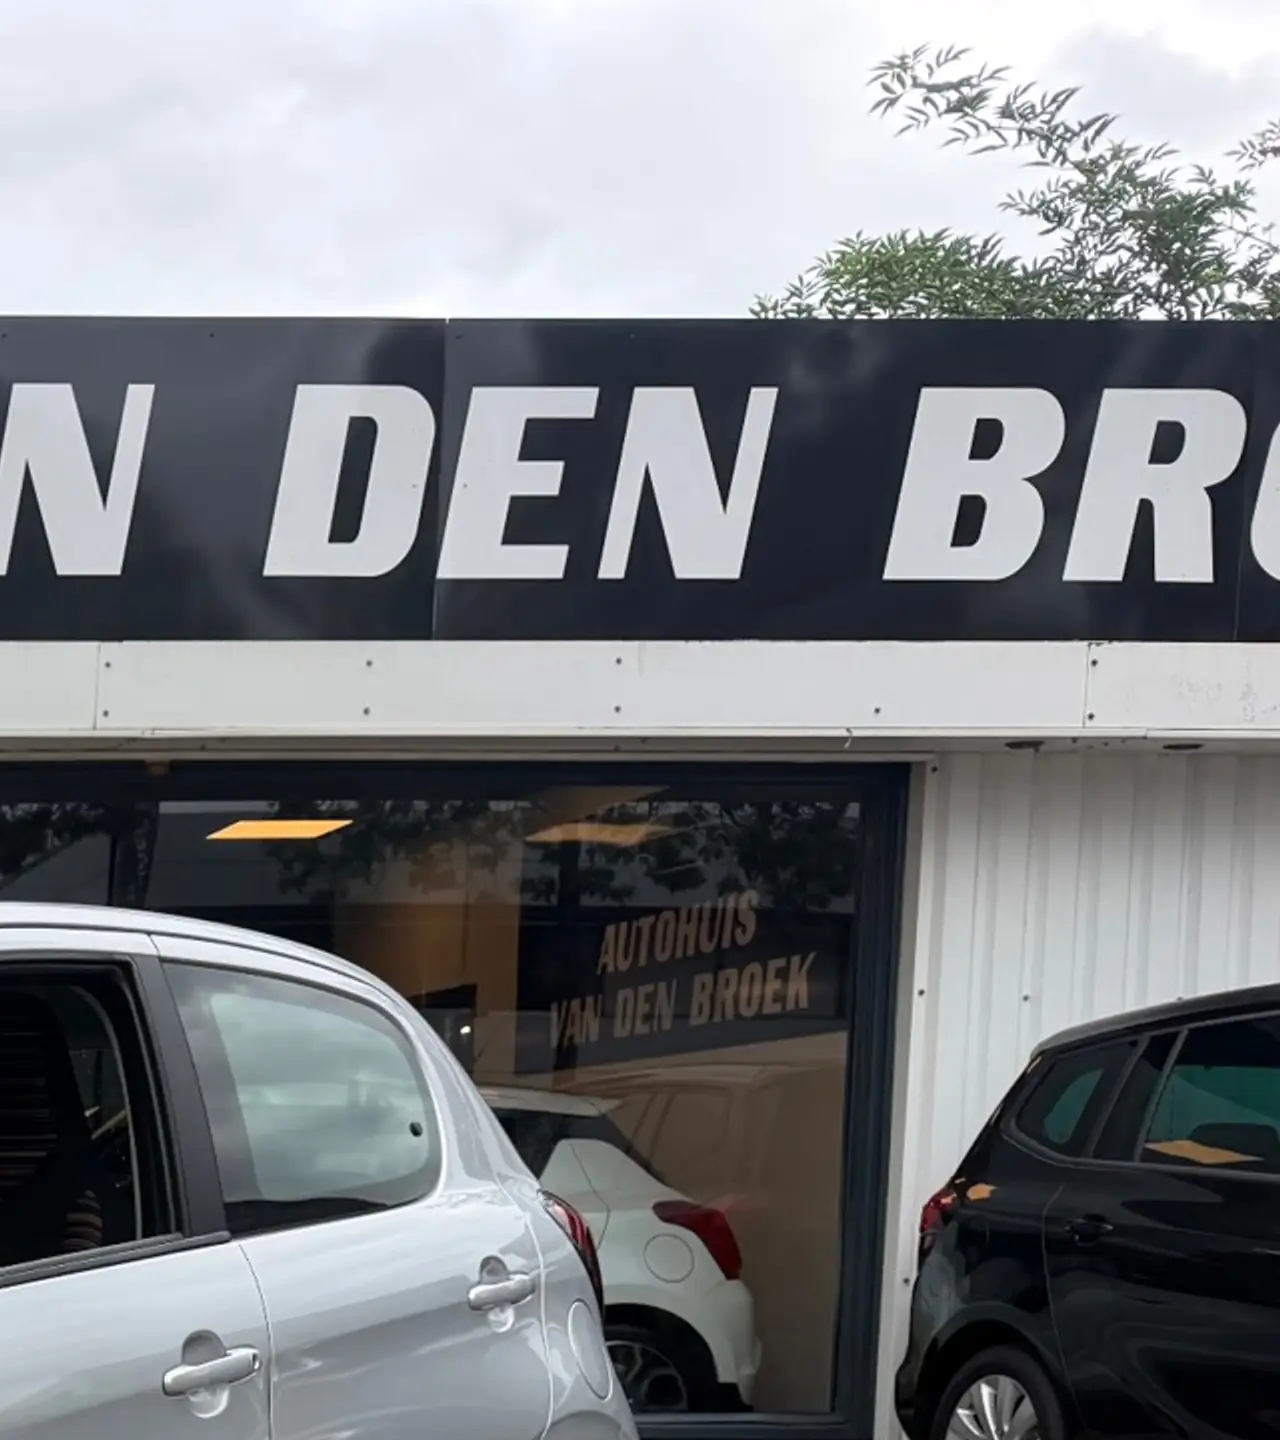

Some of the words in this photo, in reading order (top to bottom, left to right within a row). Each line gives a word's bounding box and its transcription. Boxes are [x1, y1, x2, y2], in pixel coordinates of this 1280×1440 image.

[262, 383, 780, 580] DEN
[881, 387, 1280, 583] BR
[596, 889, 760, 976] AUTOHUIS
[550, 994, 603, 1048] VAN
[613, 978, 678, 1039] DEN
[689, 951, 817, 1027] BROEK
